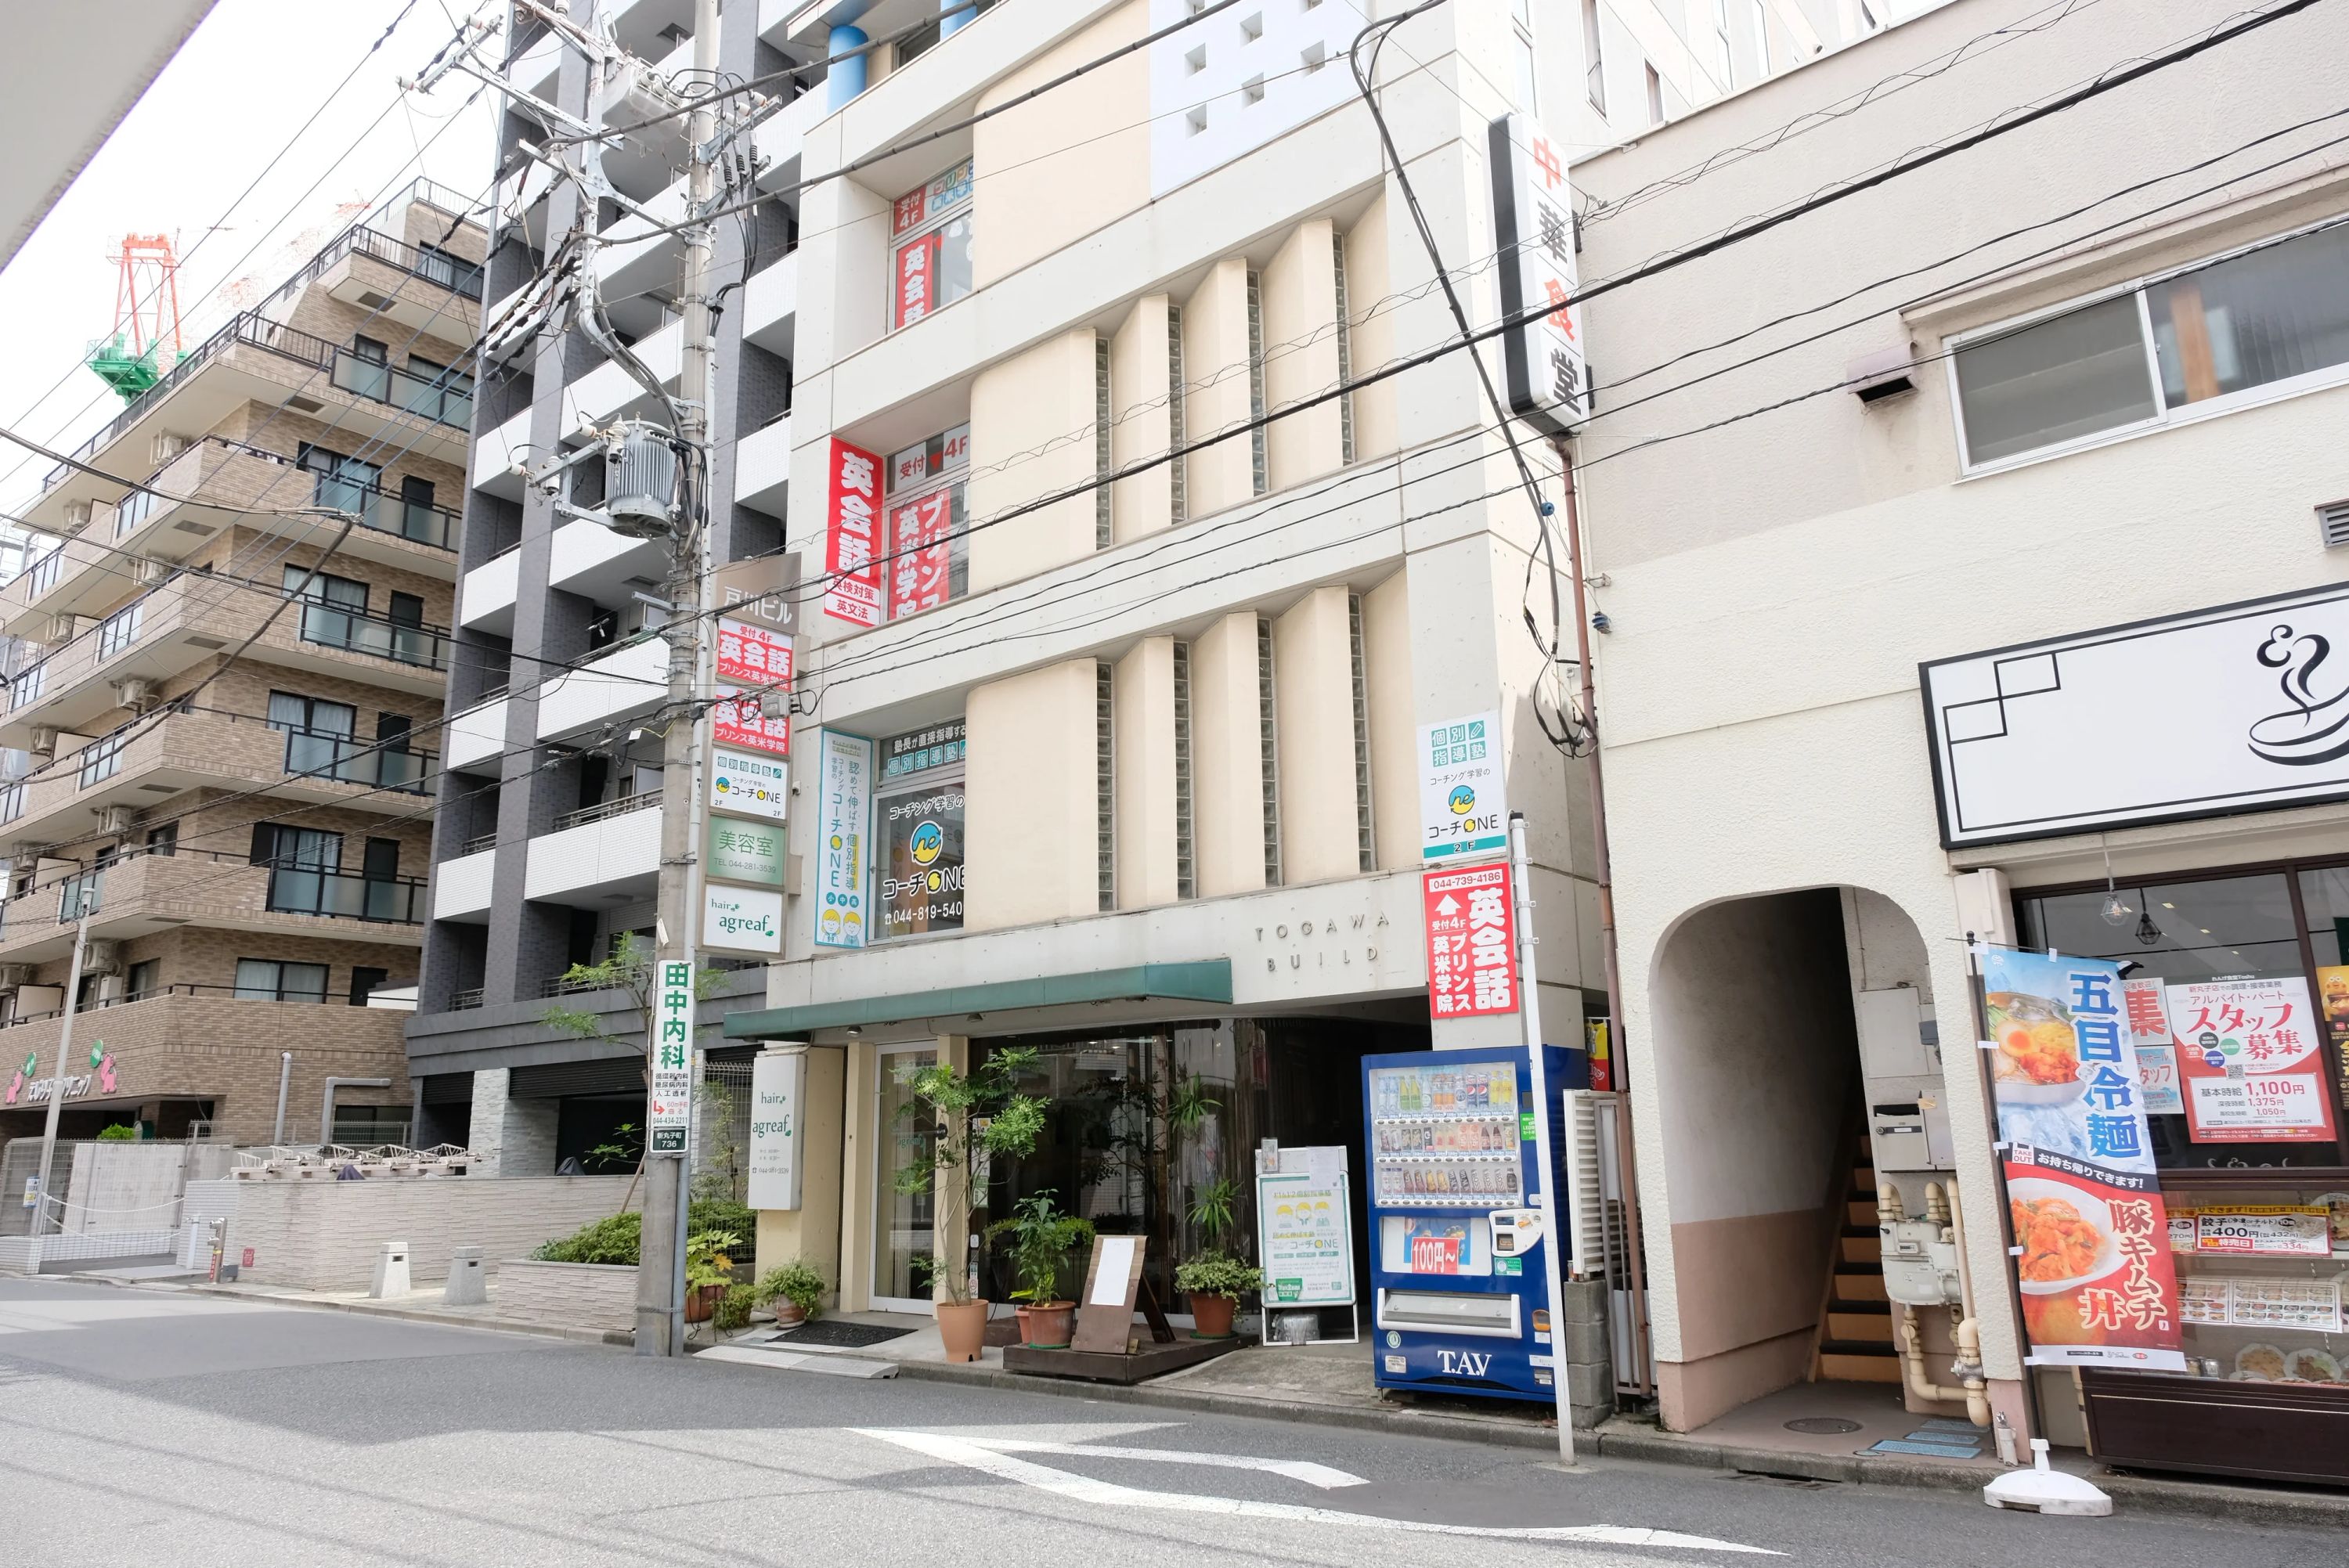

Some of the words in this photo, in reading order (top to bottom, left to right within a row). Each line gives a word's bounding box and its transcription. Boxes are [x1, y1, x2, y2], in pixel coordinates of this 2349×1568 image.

[900, 193, 920, 214] 受付
[900, 212, 918, 228] 4F
[1534, 136, 1581, 415] 中華食堂
[900, 455, 926, 480] 受付
[944, 435, 968, 459] 4F
[838, 451, 874, 578] 英会話
[833, 578, 874, 601] 英検対策
[724, 586, 792, 625] 戸川ビル
[836, 600, 868, 619] 英文法
[719, 635, 789, 676] 英会話
[716, 727, 785, 752] プリンス英米学院
[1431, 768, 1491, 786] コーチング学習の
[889, 794, 965, 820] コーチング学習の
[718, 830, 774, 857] 美容室
[714, 858, 727, 867] TEL
[728, 860, 777, 874] 044-281-3539
[1434, 872, 1501, 889] 044-739-4186
[711, 899, 730, 910] hair
[719, 915, 770, 934] agreaf
[1256, 911, 1389, 941] TOGAWA
[1432, 917, 1466, 931] 受付4F
[1268, 946, 1377, 971] BUILD
[1468, 887, 1510, 1008] 英会話
[1433, 935, 1454, 1012] 英米学院
[1451, 933, 1471, 1011] プリンス
[660, 964, 689, 1069] 田中内科
[2186, 1003, 2293, 1033] スタッフ
[2243, 1029, 2304, 1061] 募集
[2069, 972, 2142, 1159] 五目冷麺
[761, 1091, 780, 1104] hair
[2201, 1087, 2243, 1097] 基本時給
[2245, 1081, 2305, 1097] 1,100円
[2248, 1098, 2285, 1107] 1,375円
[2256, 1108, 2286, 1116] 1,050円
[752, 1114, 790, 1138] agreaf
[662, 1140, 677, 1148] 736
[2213, 1227, 2259, 1238] 400円
[2108, 1199, 2167, 1330] 豚キムチ
